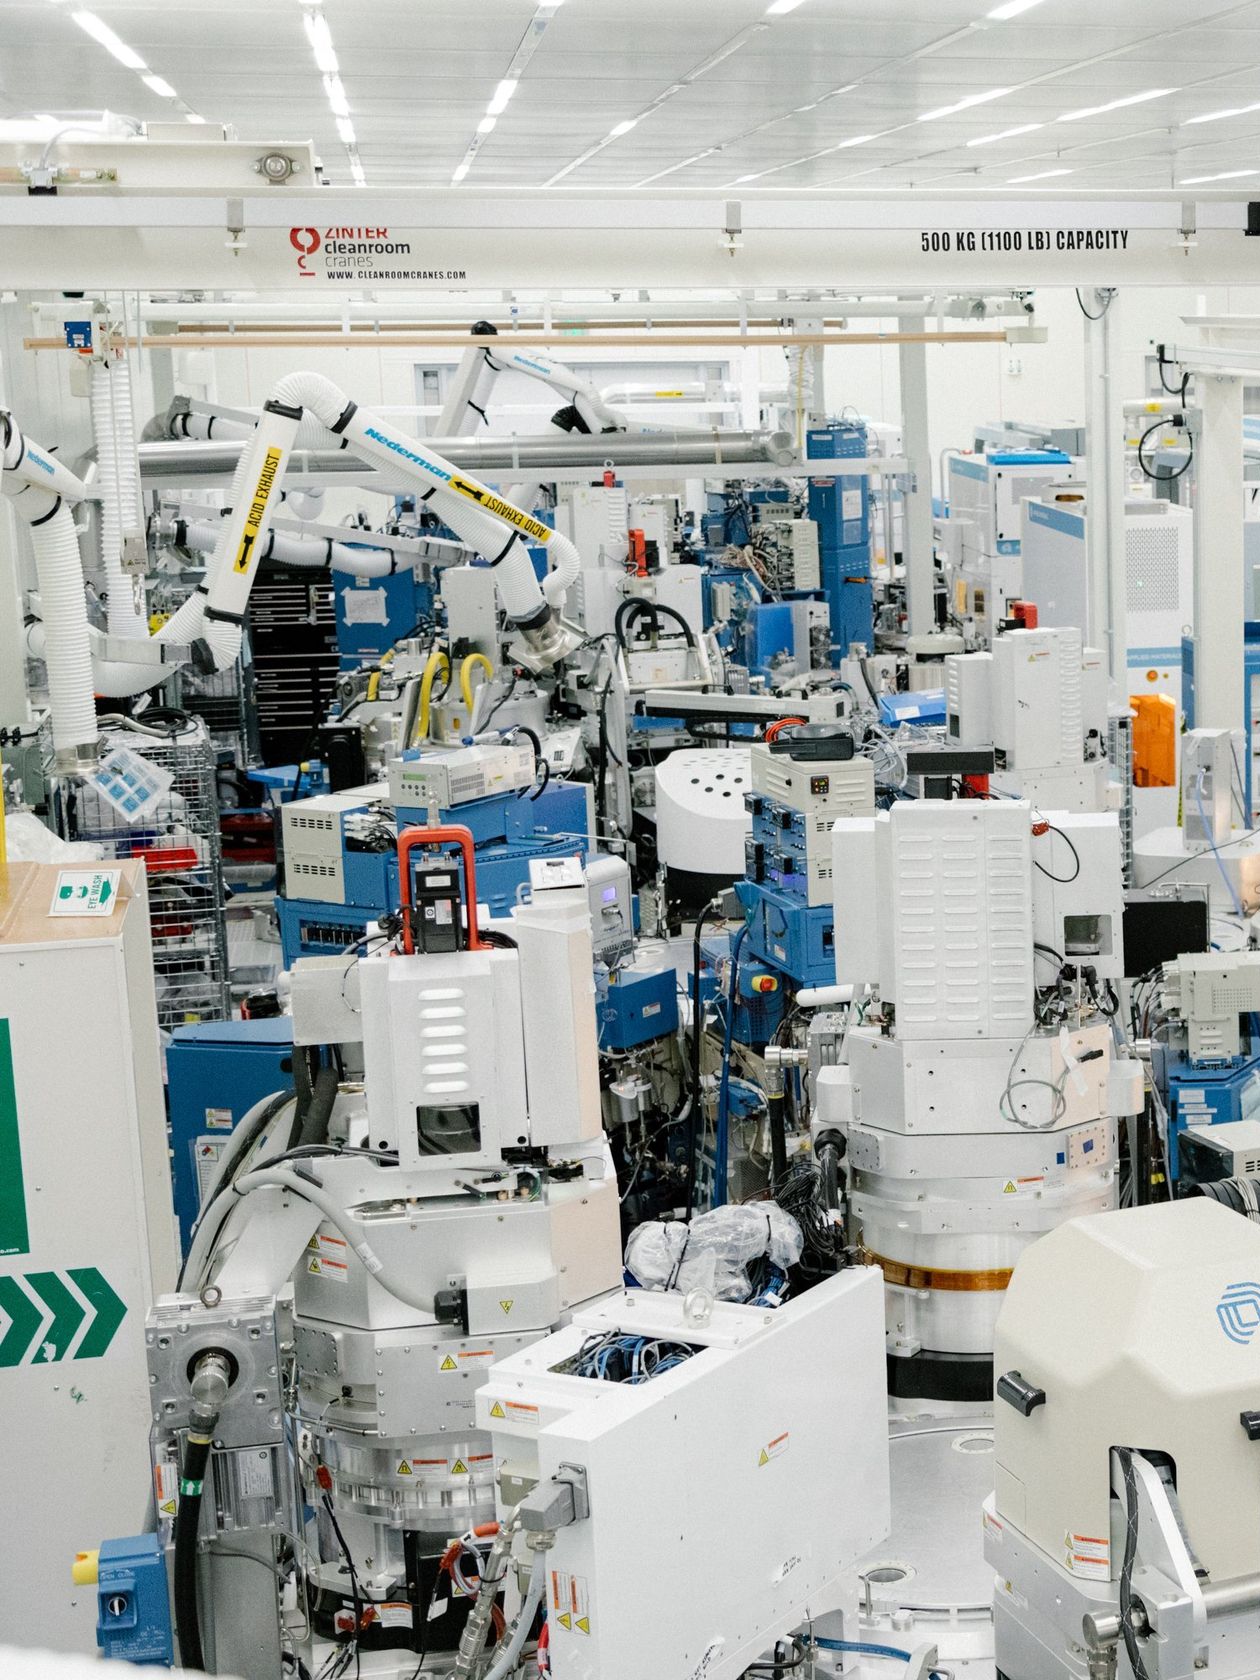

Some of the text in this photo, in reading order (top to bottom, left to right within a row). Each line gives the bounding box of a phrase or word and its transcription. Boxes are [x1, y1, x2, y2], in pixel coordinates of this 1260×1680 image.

[325, 241, 411, 254] cleanroom
[921, 230, 1129, 251] 500 KG (1100 LB) CAPACITY
[325, 256, 374, 267] cranes
[364, 427, 452, 481] Nederman
[247, 453, 280, 528] ACID EXHAUST
[483, 495, 547, 538] ACID EXHAUST
[88, 875, 103, 909] EYE WASH
